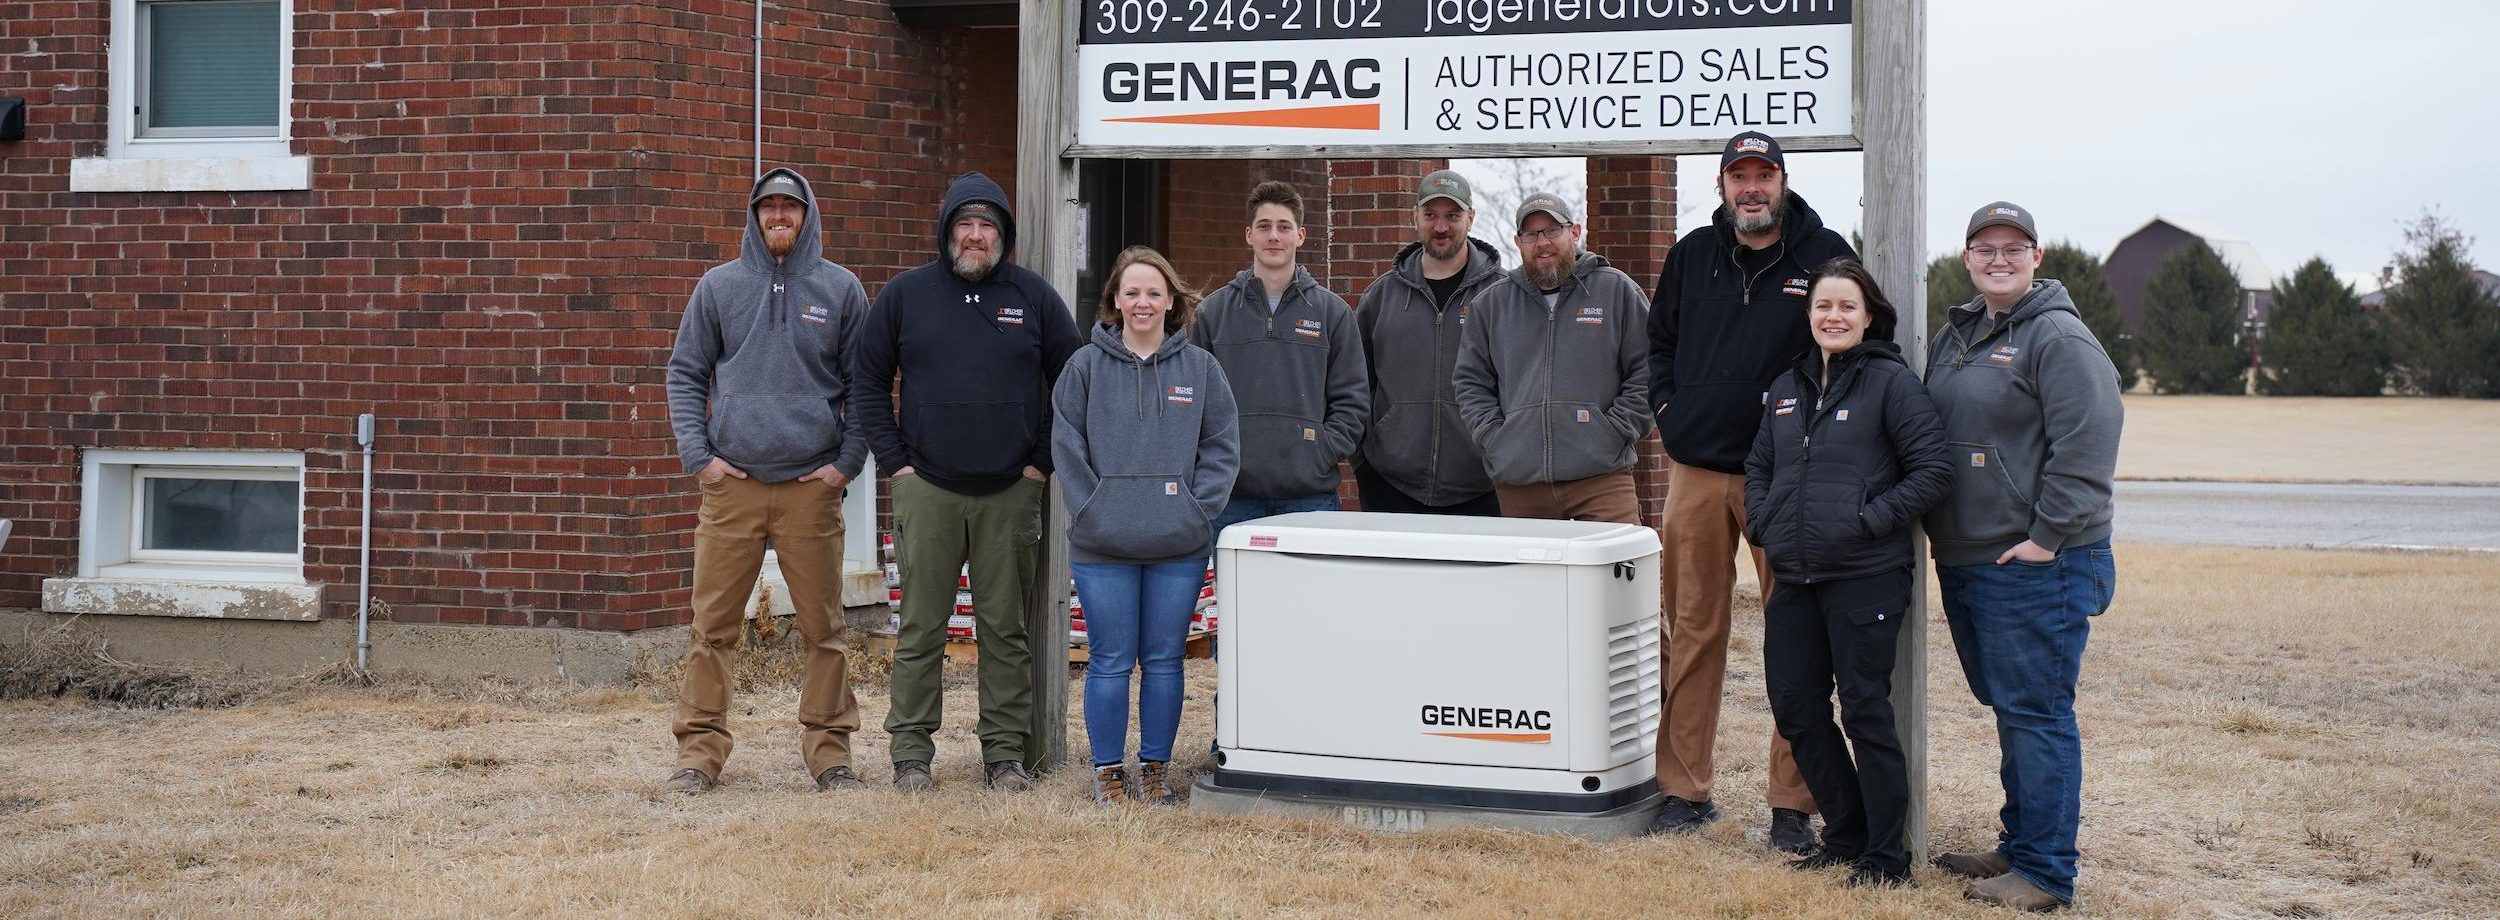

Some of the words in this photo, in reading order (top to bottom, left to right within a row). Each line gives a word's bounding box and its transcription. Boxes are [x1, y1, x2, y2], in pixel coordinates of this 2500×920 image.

[1096, 0, 1382, 34] 309-246-2102
[1102, 58, 1381, 103] GENERAC
[1435, 51, 1684, 88] AUTHORIZED
[1700, 45, 1830, 82] SALES
[1436, 98, 1462, 131] &
[1476, 95, 1641, 131] SERVICE
[1659, 91, 1818, 128] DEALER
[1421, 705, 1551, 731] GENERAC
